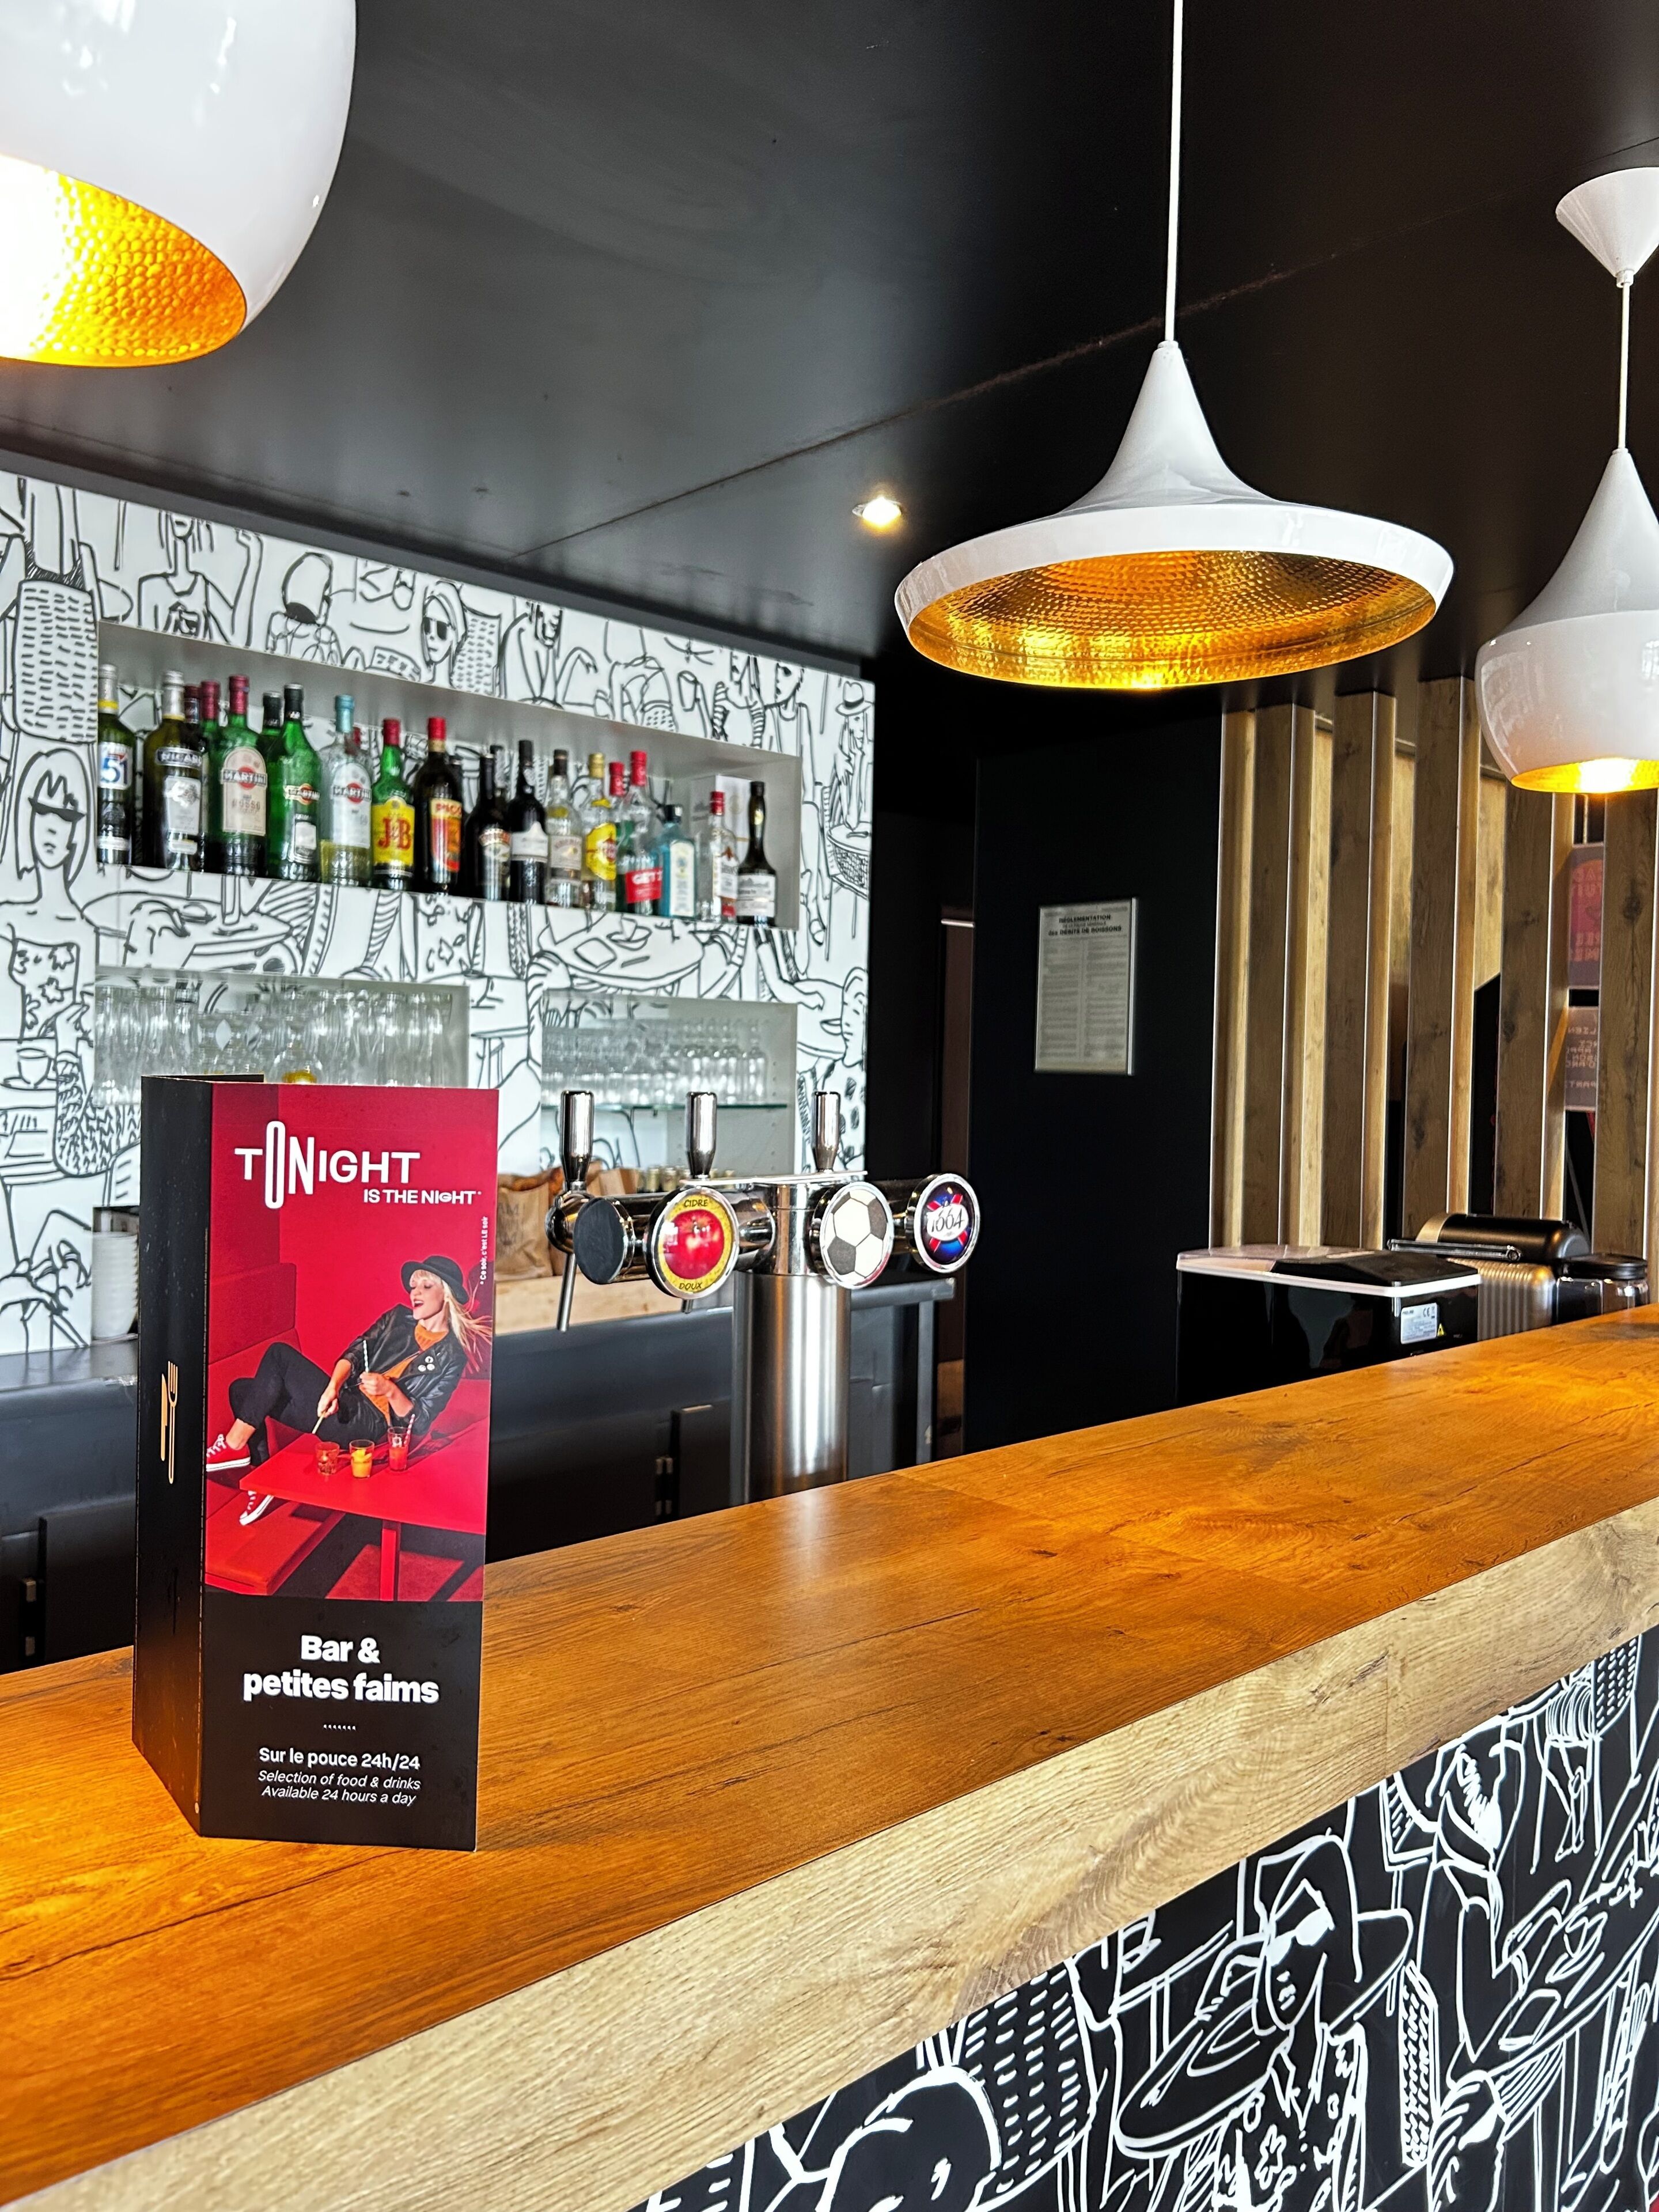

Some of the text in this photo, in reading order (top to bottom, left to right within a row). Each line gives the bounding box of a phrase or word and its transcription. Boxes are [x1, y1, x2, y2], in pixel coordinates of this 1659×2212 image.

[100, 757, 128, 784] 51
[224, 770, 266, 785] MARTINI
[334, 787, 372, 801] MARTINI
[234, 1121, 421, 1209] TONIGHT
[364, 1189, 380, 1203] IS
[382, 1190, 418, 1204] THE
[684, 1199, 709, 1207] CIDRE
[931, 1208, 964, 1233] 1664
[301, 1635, 380, 1664] Bar &
[244, 1669, 439, 1703] petites faims
[259, 1747, 421, 1771] Sur le pouce 24h/24
[258, 1770, 421, 1790] Selection of food & drinks
[262, 1786, 416, 1807] Available 24 hours a day
